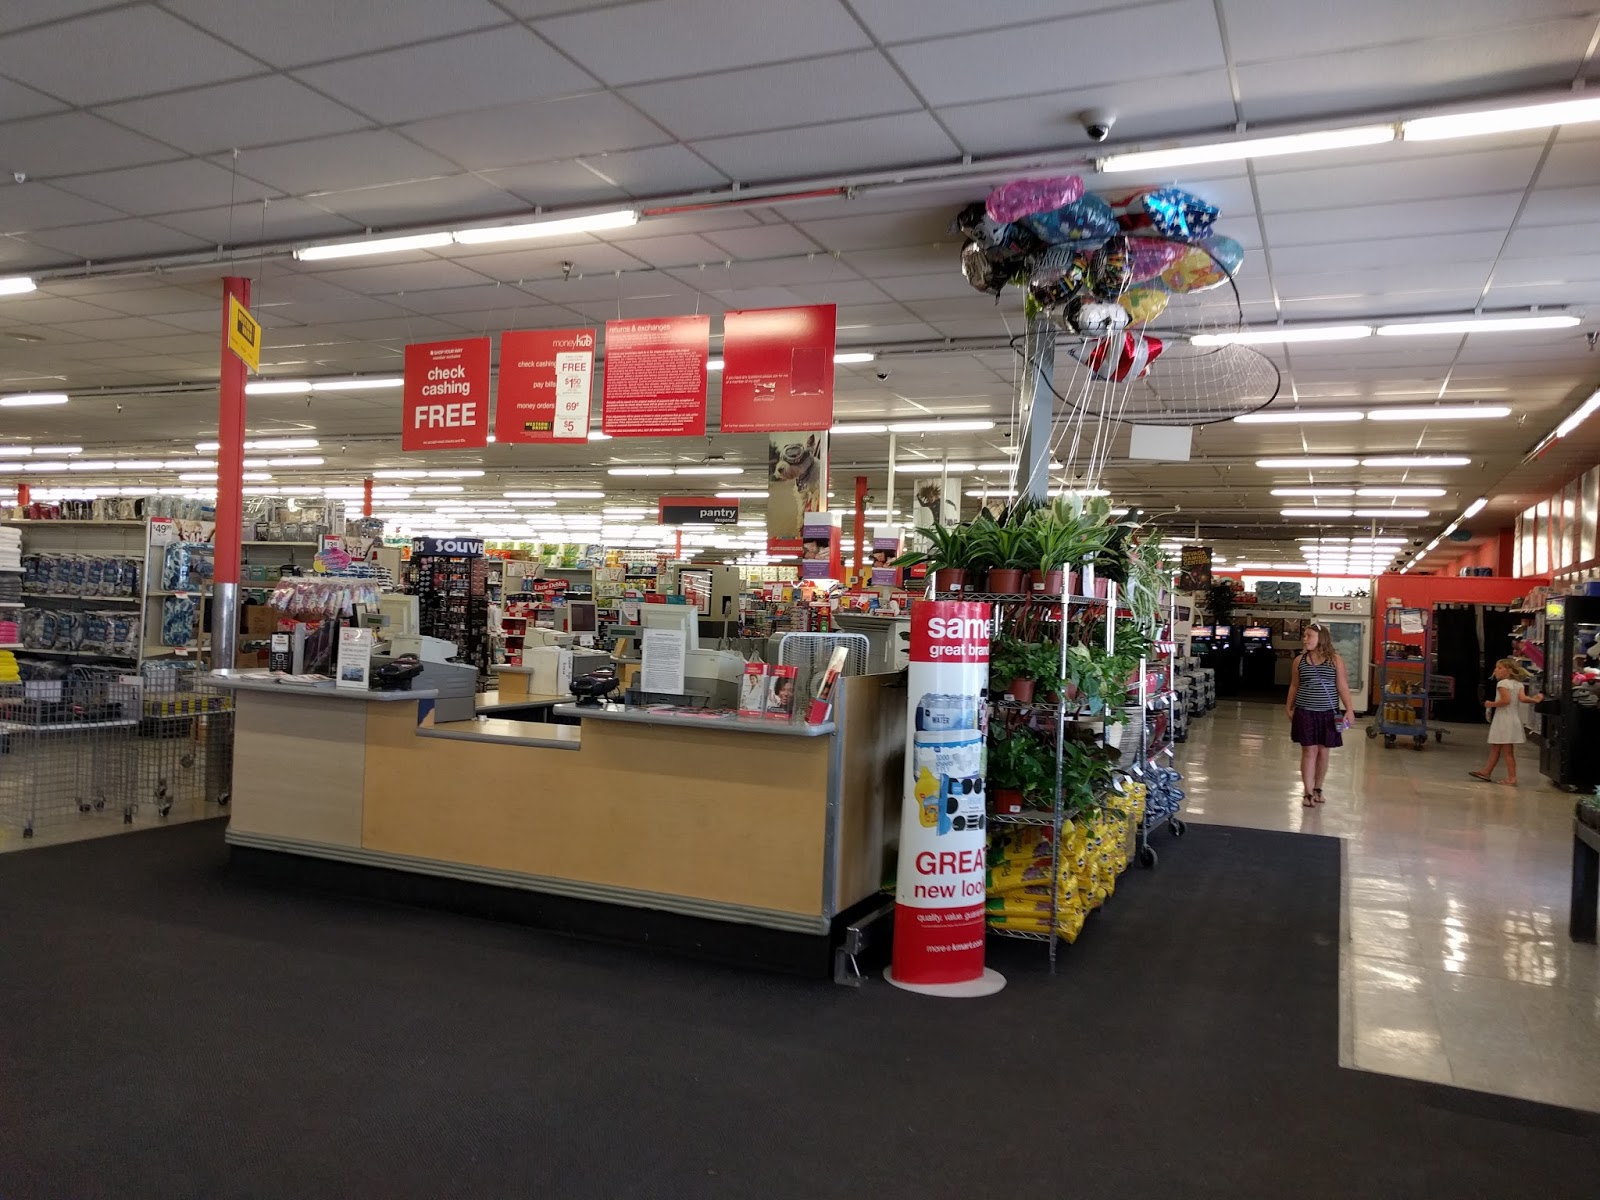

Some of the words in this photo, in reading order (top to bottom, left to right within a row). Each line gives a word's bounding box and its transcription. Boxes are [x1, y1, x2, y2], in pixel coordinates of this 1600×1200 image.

[552, 333, 593, 350] moneyhub
[428, 364, 466, 380] check
[562, 362, 586, 372] FREE
[422, 380, 470, 396] cashing
[517, 402, 536, 411] money
[415, 402, 476, 429] FREE
[564, 420, 574, 432] $5
[700, 508, 736, 519] pantry
[348, 546, 366, 558] SALE
[435, 539, 483, 554] SOUVE
[1330, 602, 1351, 610] ICE
[930, 643, 966, 658] great
[932, 716, 950, 724] WATER
[914, 884, 956, 898] new
